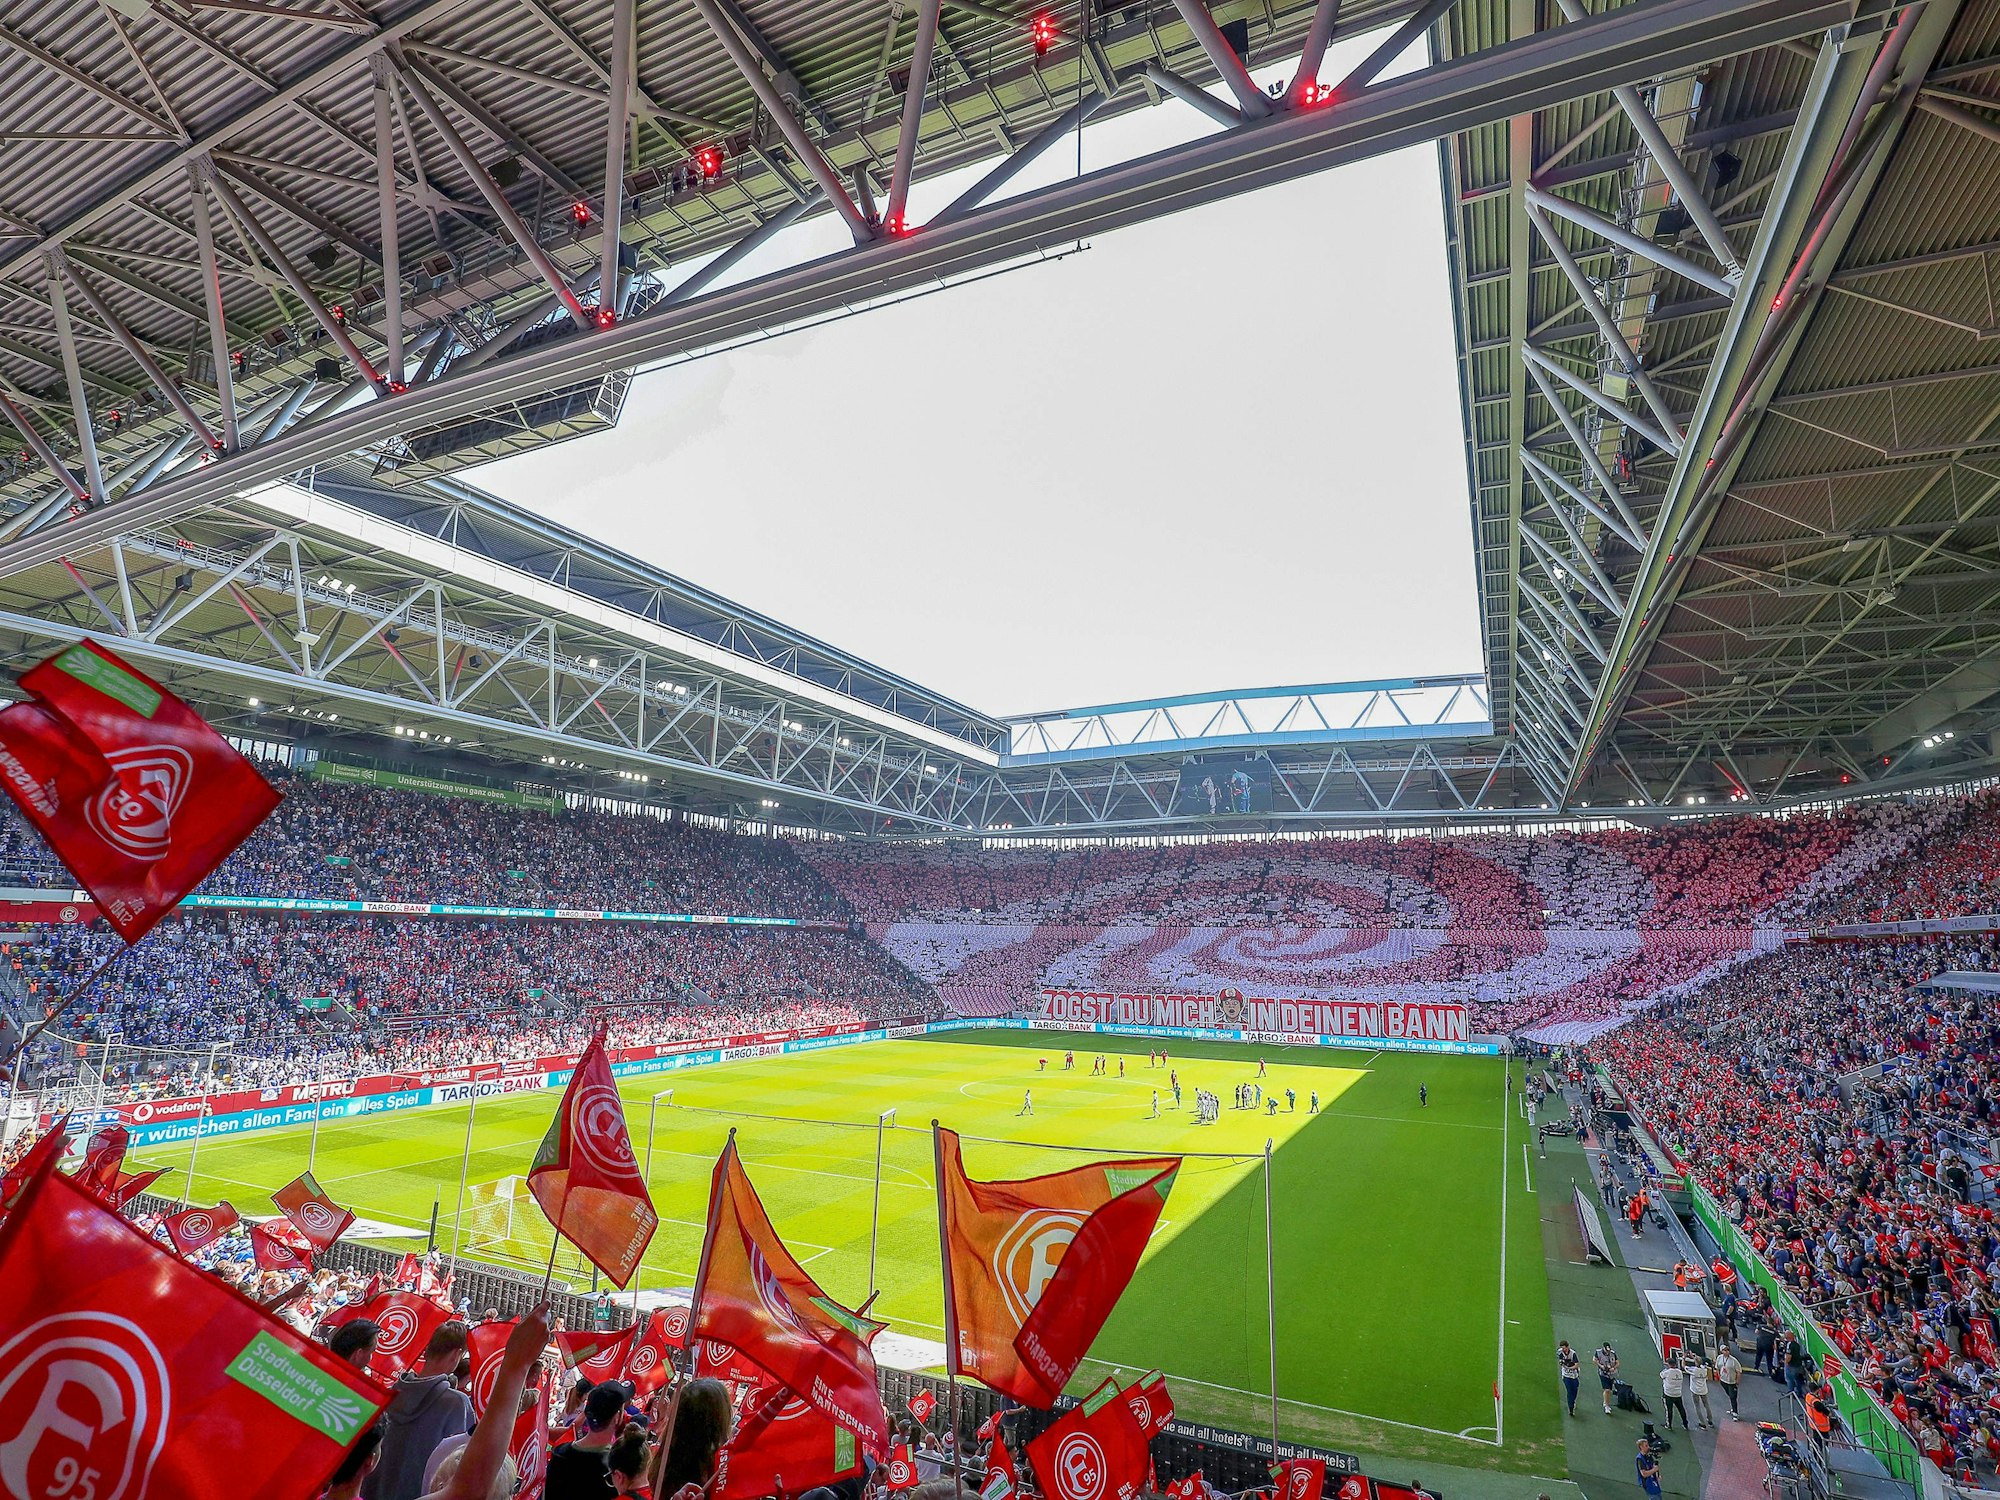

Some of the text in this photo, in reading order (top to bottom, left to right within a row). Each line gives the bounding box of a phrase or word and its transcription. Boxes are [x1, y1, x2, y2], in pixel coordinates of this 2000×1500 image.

[397, 775, 453, 793] Unterstützung
[454, 785, 469, 794] von
[469, 787, 487, 798] ganz
[197, 897, 212, 905] Wir
[214, 898, 257, 907] wünschen
[331, 902, 349, 910] Spiel
[1040, 989, 1468, 1041] ZOGST DU MICH IN DEINEN BANN
[1101, 1024, 1114, 1033] Wir
[1115, 1025, 1149, 1035] wünschen
[1149, 1027, 1166, 1036] allen
[1167, 1028, 1183, 1036] Fans
[789, 1041, 800, 1051] Wir
[800, 1039, 827, 1050] wünschen
[1327, 1036, 1342, 1045] Wir
[1343, 1037, 1385, 1048] wünschen
[1385, 1040, 1406, 1049] allen
[1407, 1041, 1427, 1051] Fans
[1427, 1043, 1441, 1051] ein
[1467, 1044, 1489, 1054] Spiel
[558, 1071, 572, 1083] Wi
[622, 1061, 642, 1076] allen
[642, 1059, 662, 1073] Fans
[662, 1059, 675, 1070] ein
[696, 1052, 714, 1067] Spiel
[292, 1081, 355, 1101] METRO
[104, 1112, 120, 1122] 94
[128, 1131, 144, 1145] ir
[142, 1114, 240, 1144] wünschen
[242, 1110, 281, 1129] allen
[285, 1105, 318, 1124] Fans
[322, 1104, 344, 1118] ein
[386, 1091, 419, 1112] Spiel
[477, 1262, 498, 1274] KÜCHEN
[522, 1273, 543, 1285] KÜCHEN
[255, 1341, 327, 1397] Stadtwerke
[238, 1355, 315, 1412] Düsseldorf
[814, 1375, 836, 1401] EINE
[810, 1387, 880, 1444] MANNSCHAFT.
[1178, 1424, 1195, 1437] and
[1197, 1427, 1210, 1439] all
[1212, 1431, 1243, 1447] hotels
[1256, 1440, 1273, 1453] me
[1276, 1444, 1294, 1458] and
[46, 1456, 101, 1500] 95
[1083, 1468, 1097, 1486] 95
